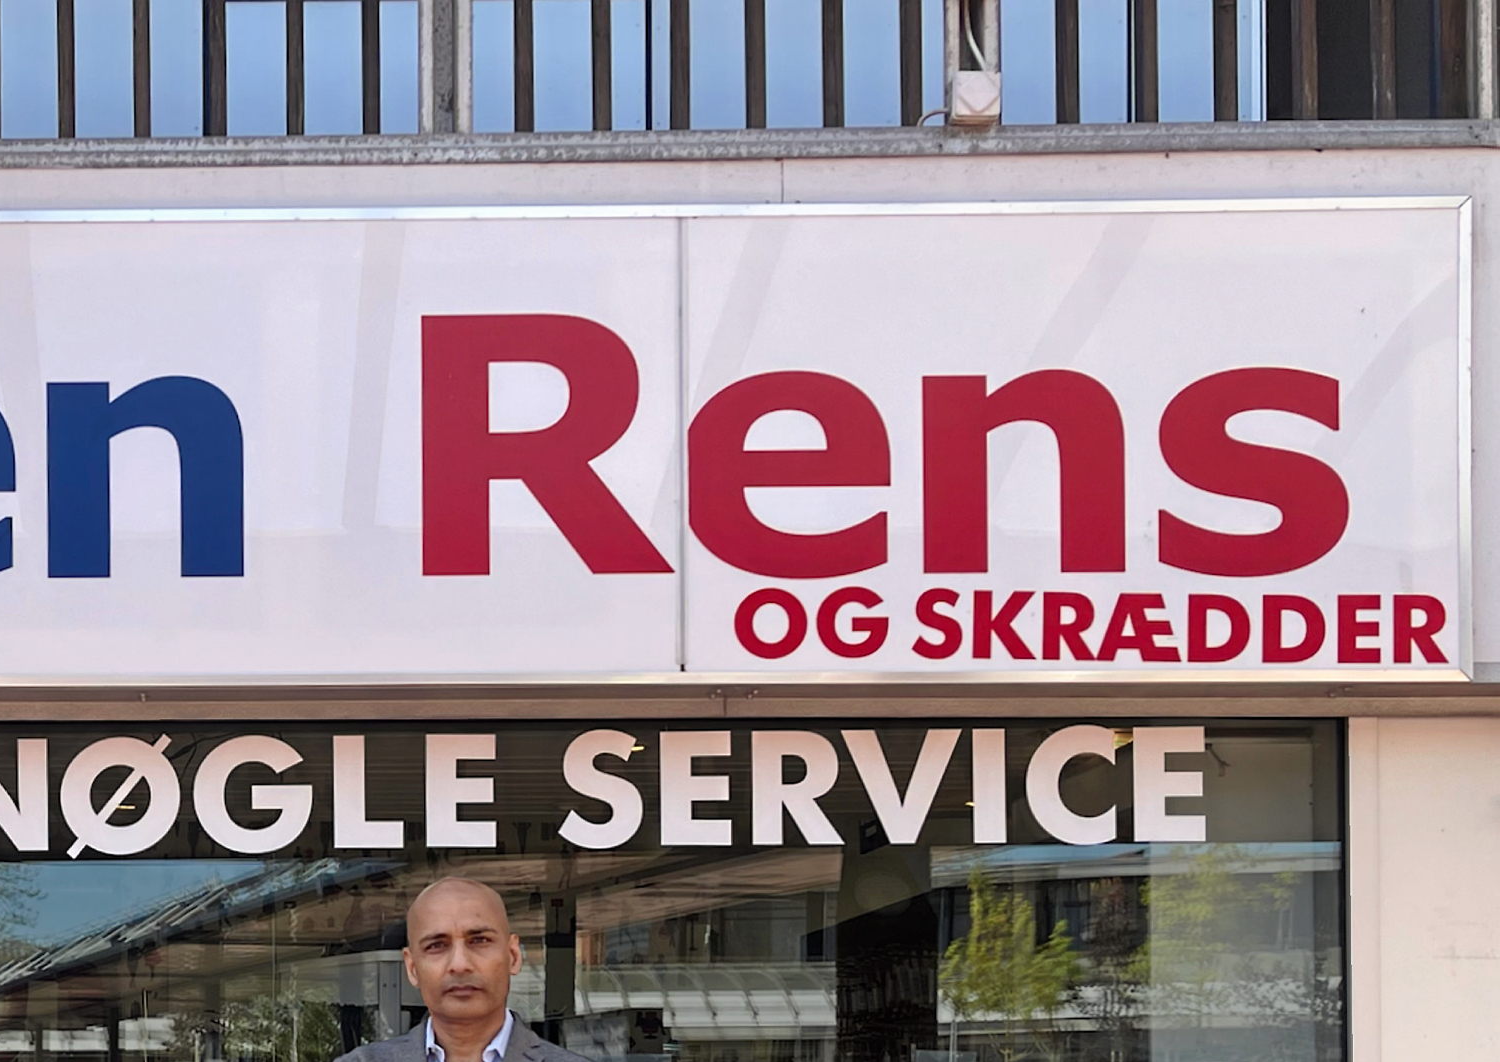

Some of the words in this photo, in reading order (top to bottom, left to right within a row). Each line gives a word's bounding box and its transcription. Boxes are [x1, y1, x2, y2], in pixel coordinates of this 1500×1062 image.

[421, 315, 1348, 578] Rens
[734, 586, 888, 659] OG
[913, 588, 1447, 663] SKRÆDDER
[559, 726, 1207, 850] SERVICE
